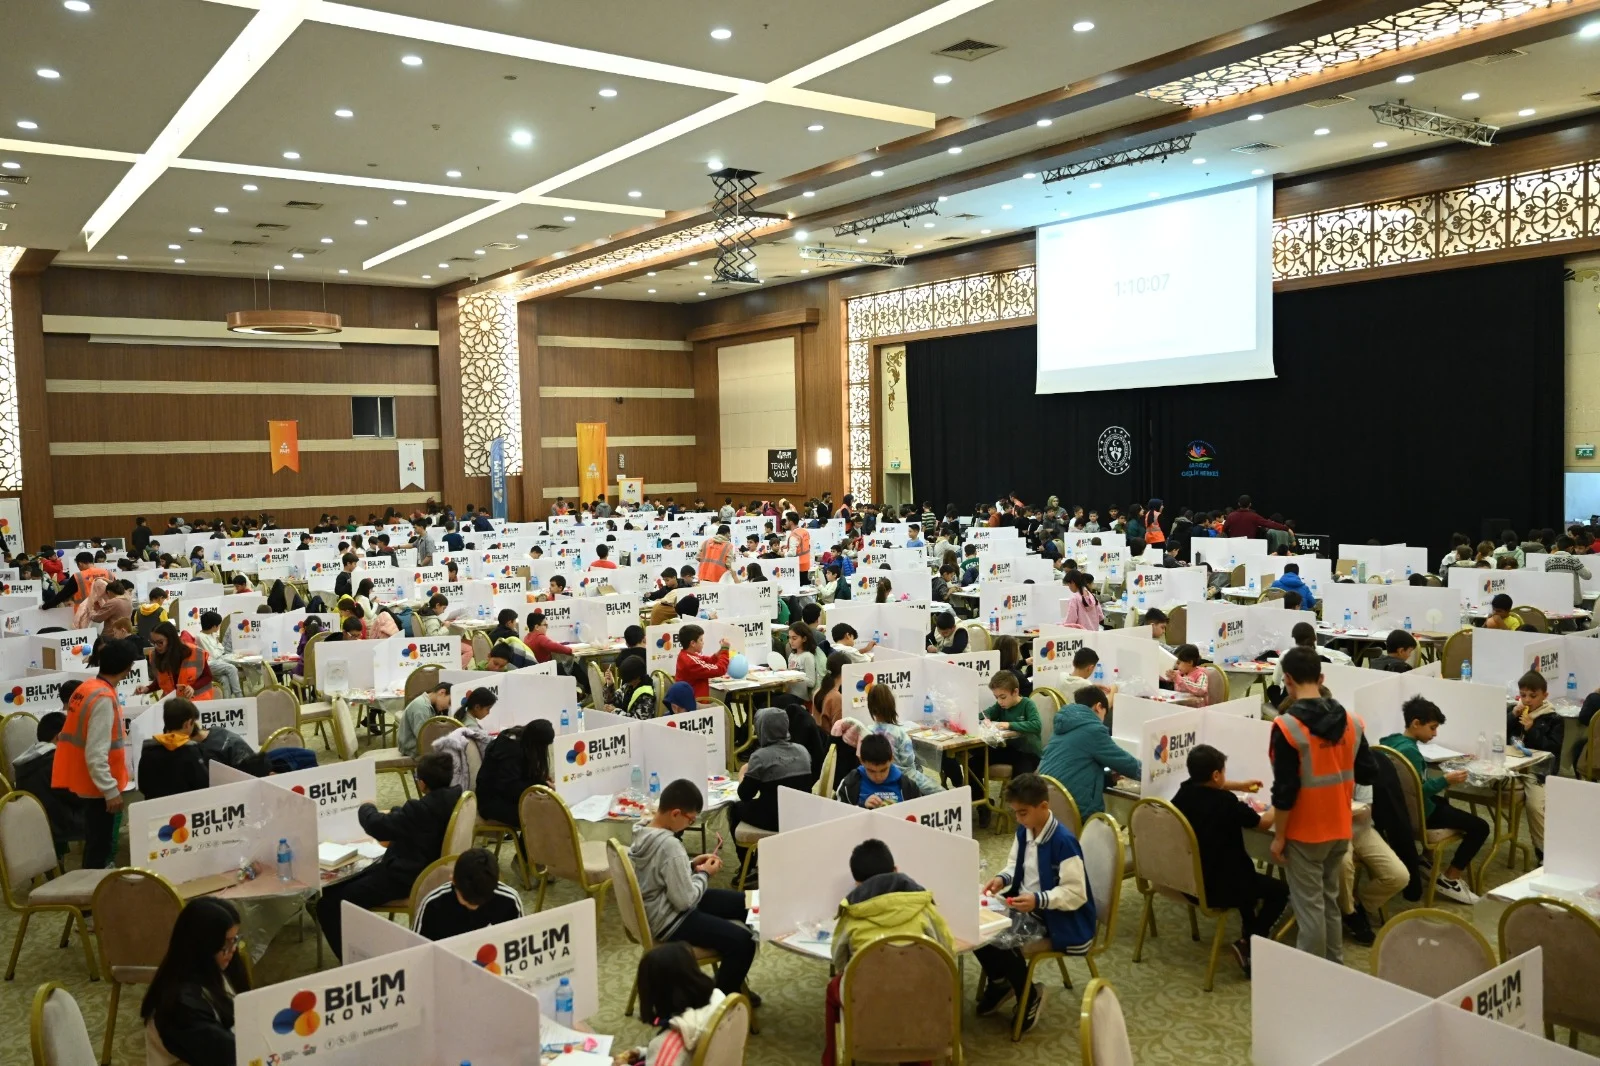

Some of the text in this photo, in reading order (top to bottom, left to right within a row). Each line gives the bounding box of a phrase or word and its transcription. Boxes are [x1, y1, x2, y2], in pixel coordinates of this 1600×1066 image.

[1114, 274, 1170, 296] 1:10:07
[771, 461, 790, 470] TEKNİK
[1492, 579, 1505, 587] BiLiM
[697, 593, 718, 601] BiLiM
[1012, 594, 1026, 603] BiLiM
[545, 607, 570, 616] BiLiM
[606, 602, 630, 611] BiLiM
[1228, 620, 1243, 631] BiLiM
[60, 636, 87, 646] BiLiM
[420, 642, 450, 653] BiLiM
[1057, 640, 1083, 652] BiLiM
[1541, 652, 1558, 666] BiLiM
[877, 671, 910, 684] BiLiM
[26, 683, 61, 696] BiLiM
[201, 709, 243, 724] BiLiM
[589, 734, 626, 753] BiLiM
[1170, 732, 1196, 750] BiLiM
[590, 748, 626, 761] KONYA
[309, 777, 356, 799] BiLiM
[320, 792, 356, 806] ONYA
[192, 804, 245, 828] BiLiM
[192, 820, 244, 838] KONYA
[504, 924, 570, 963] BiLiM
[505, 946, 570, 975] KONYA
[325, 968, 405, 1012] BiLiM
[1477, 969, 1521, 1016] BiLiM
[325, 994, 405, 1026] KONYA
